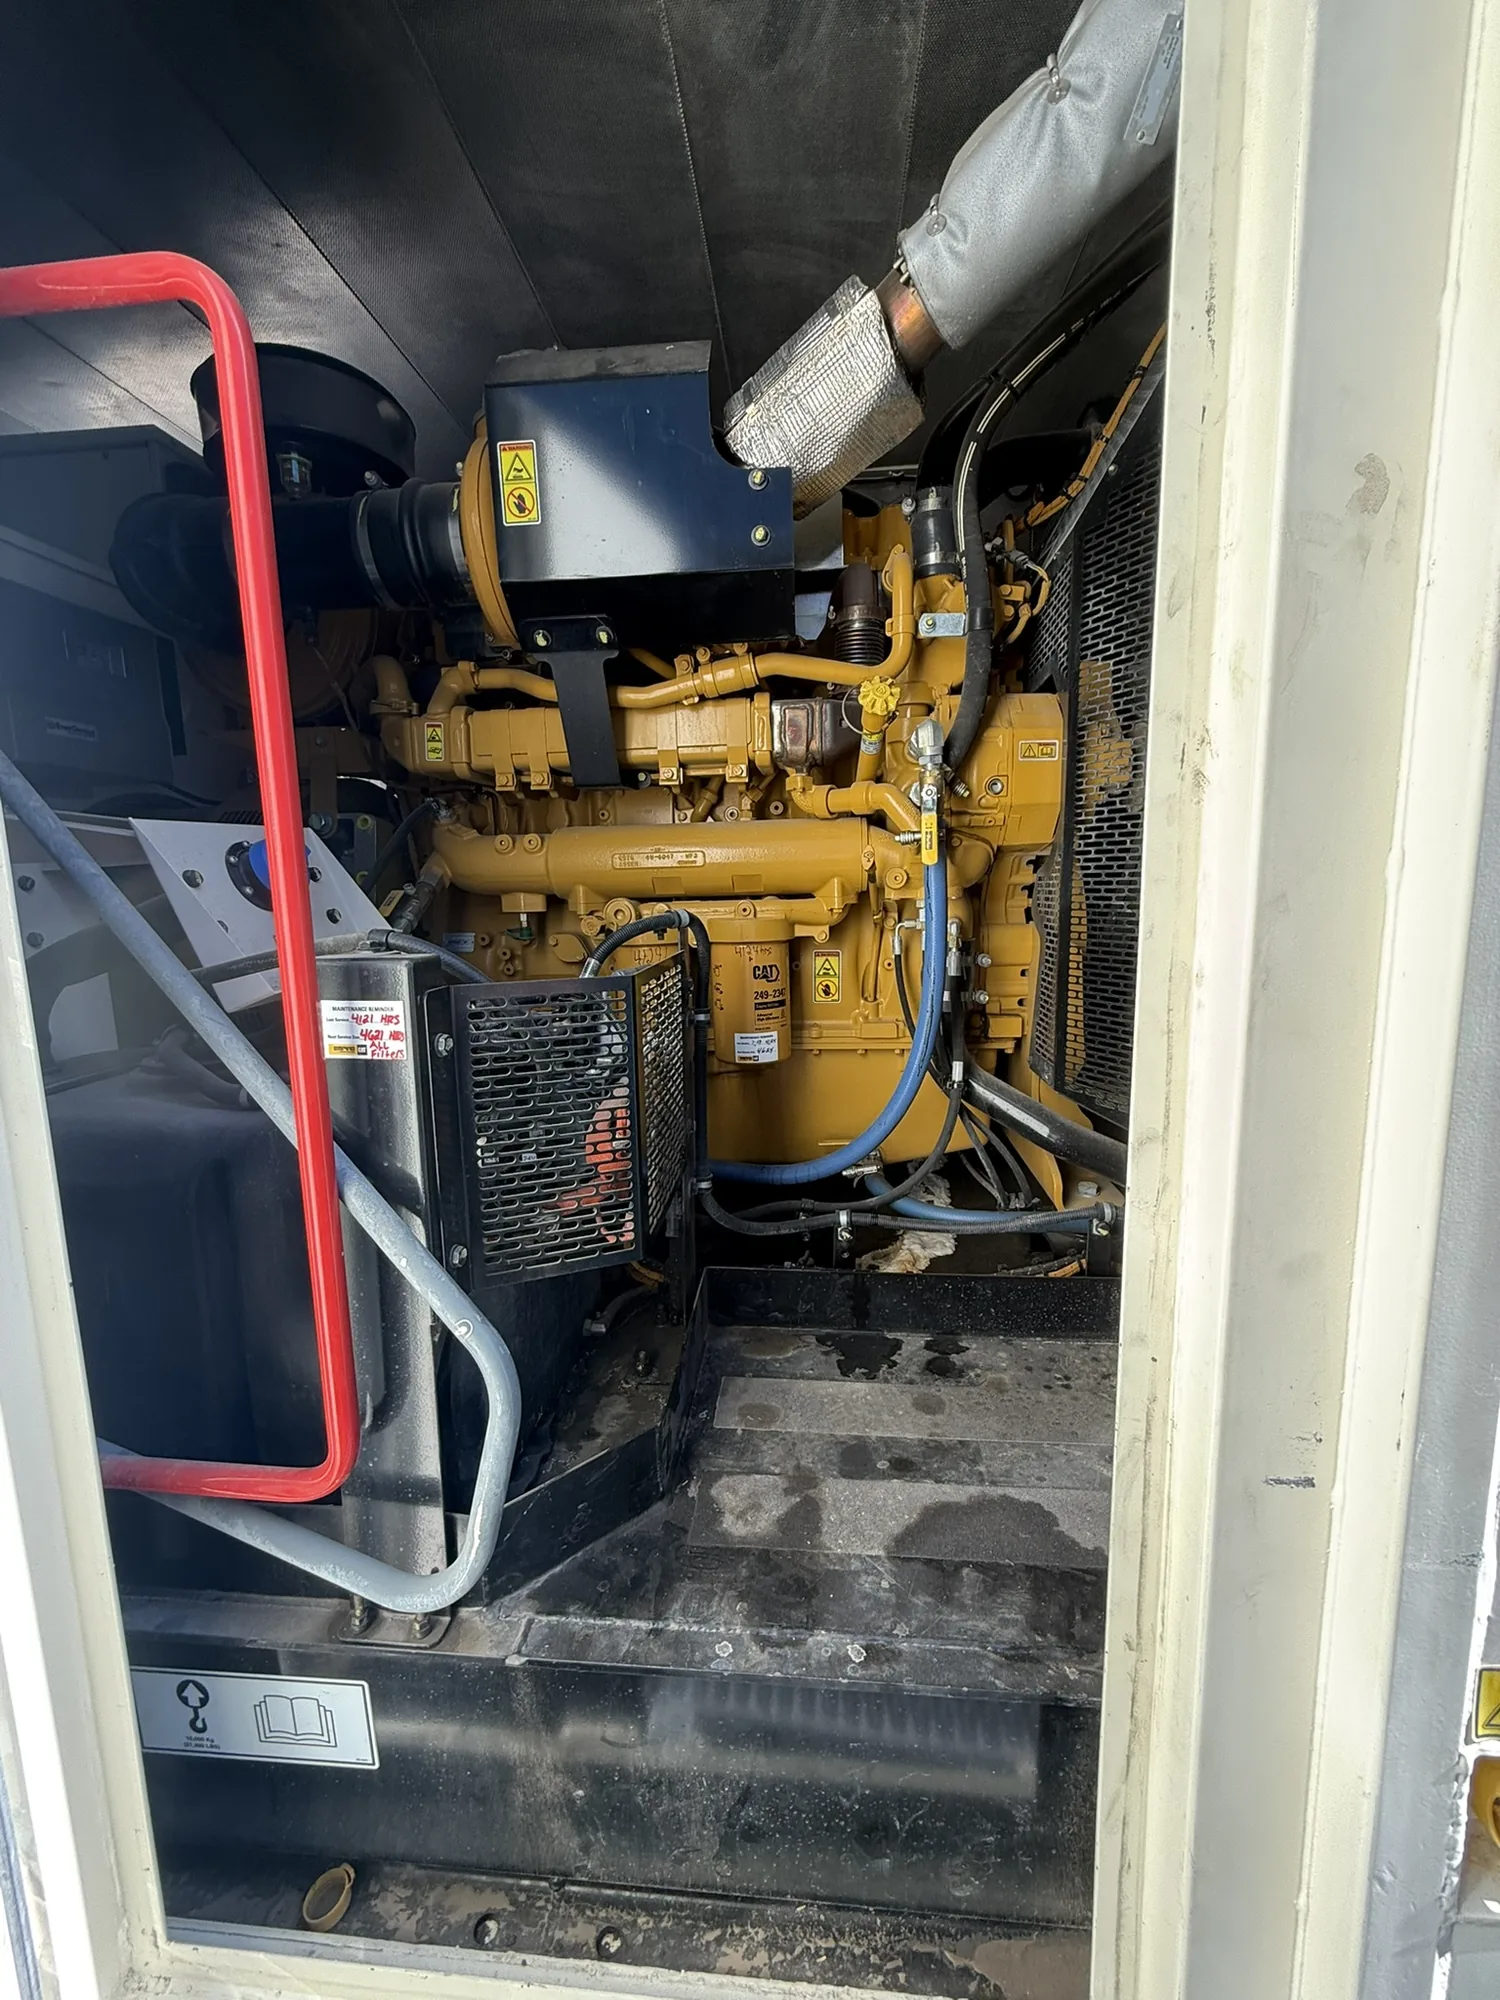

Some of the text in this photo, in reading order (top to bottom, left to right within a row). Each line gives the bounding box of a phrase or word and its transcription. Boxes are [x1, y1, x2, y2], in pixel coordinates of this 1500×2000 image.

[753, 964, 780, 983] CAT
[380, 1014, 400, 1025] HRS
[369, 1041, 389, 1051] ALL
